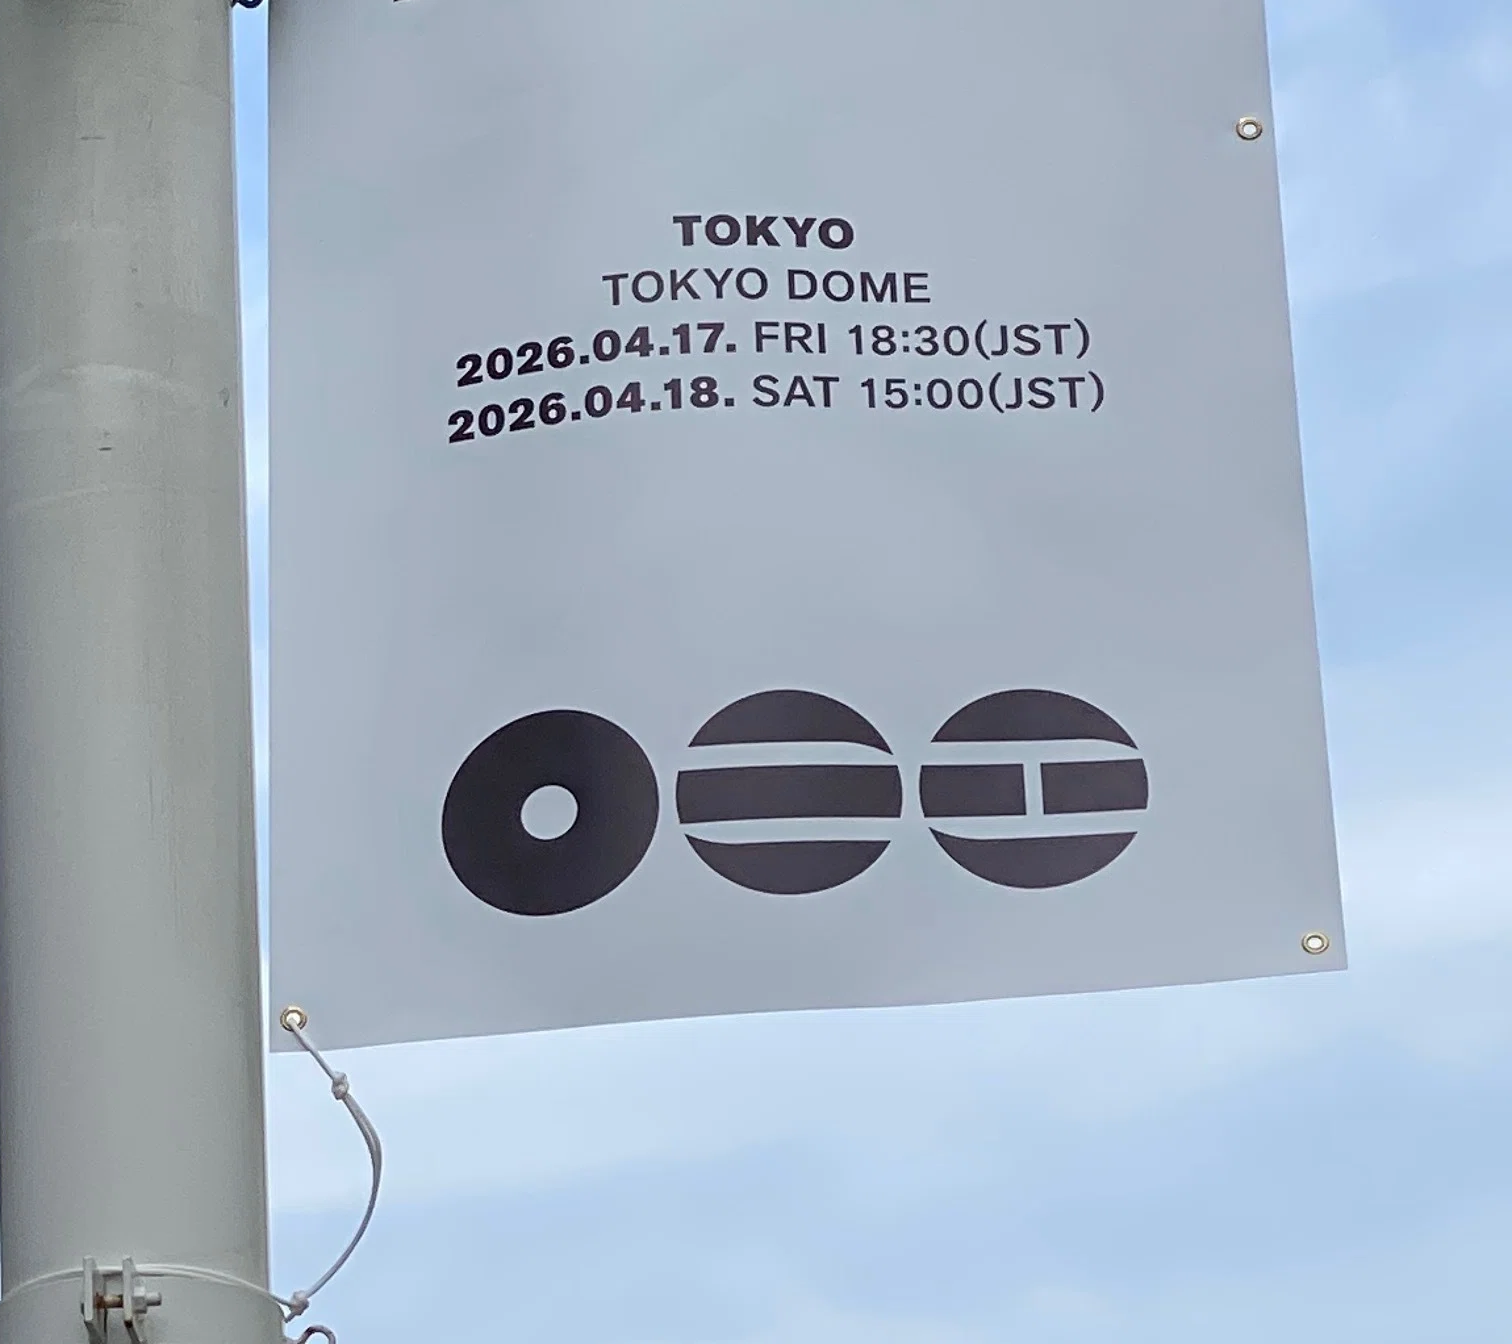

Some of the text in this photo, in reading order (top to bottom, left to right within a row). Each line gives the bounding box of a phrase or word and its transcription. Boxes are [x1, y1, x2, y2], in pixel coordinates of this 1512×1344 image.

[672, 214, 855, 250] TOKYO
[602, 267, 931, 306] TOKYO DOME
[455, 318, 1091, 388] 2026.04.17. FRI 18:30(JST)
[447, 371, 1105, 444] 2026.04.18. SAT 15:00(JST)
